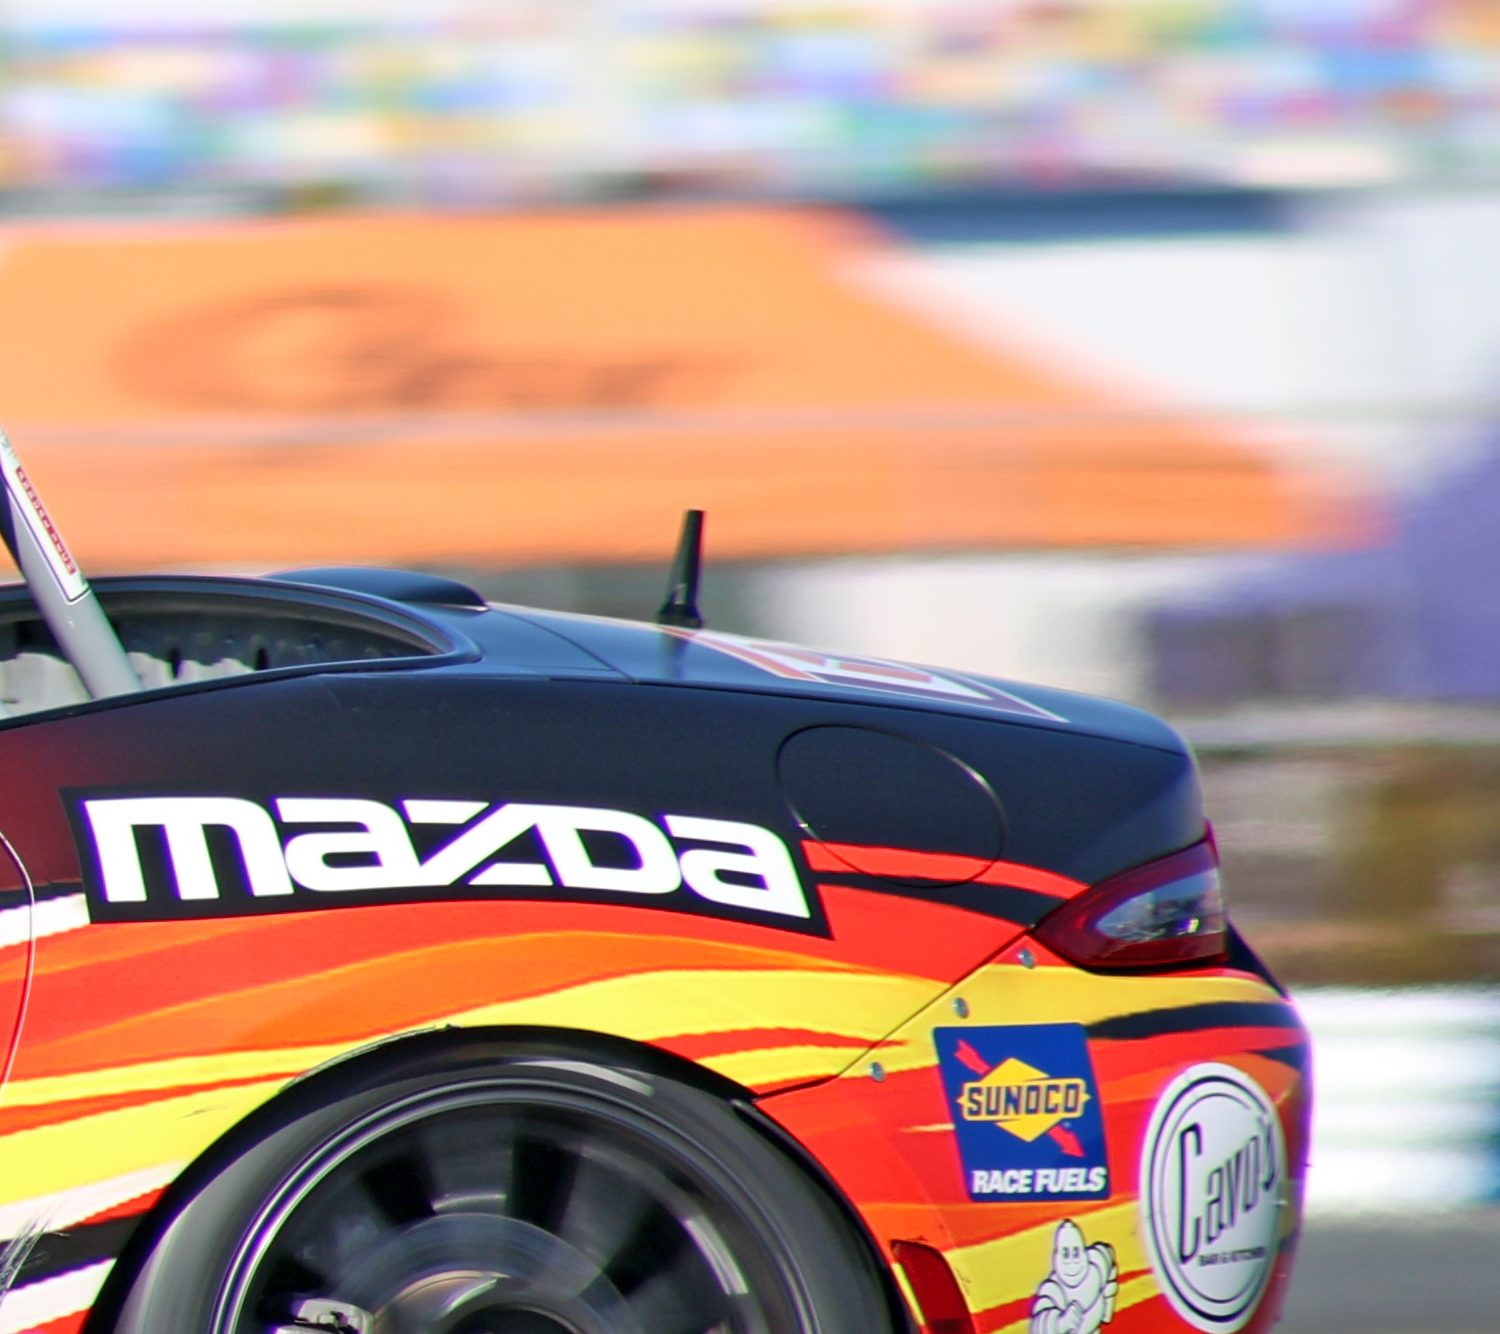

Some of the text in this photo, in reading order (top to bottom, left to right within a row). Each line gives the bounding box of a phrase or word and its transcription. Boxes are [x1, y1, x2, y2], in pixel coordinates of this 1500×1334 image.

[967, 1082, 1080, 1117] SUNOCO
[971, 1166, 1109, 1195] RACE FUELS
[1179, 1116, 1279, 1265] Cavo's
